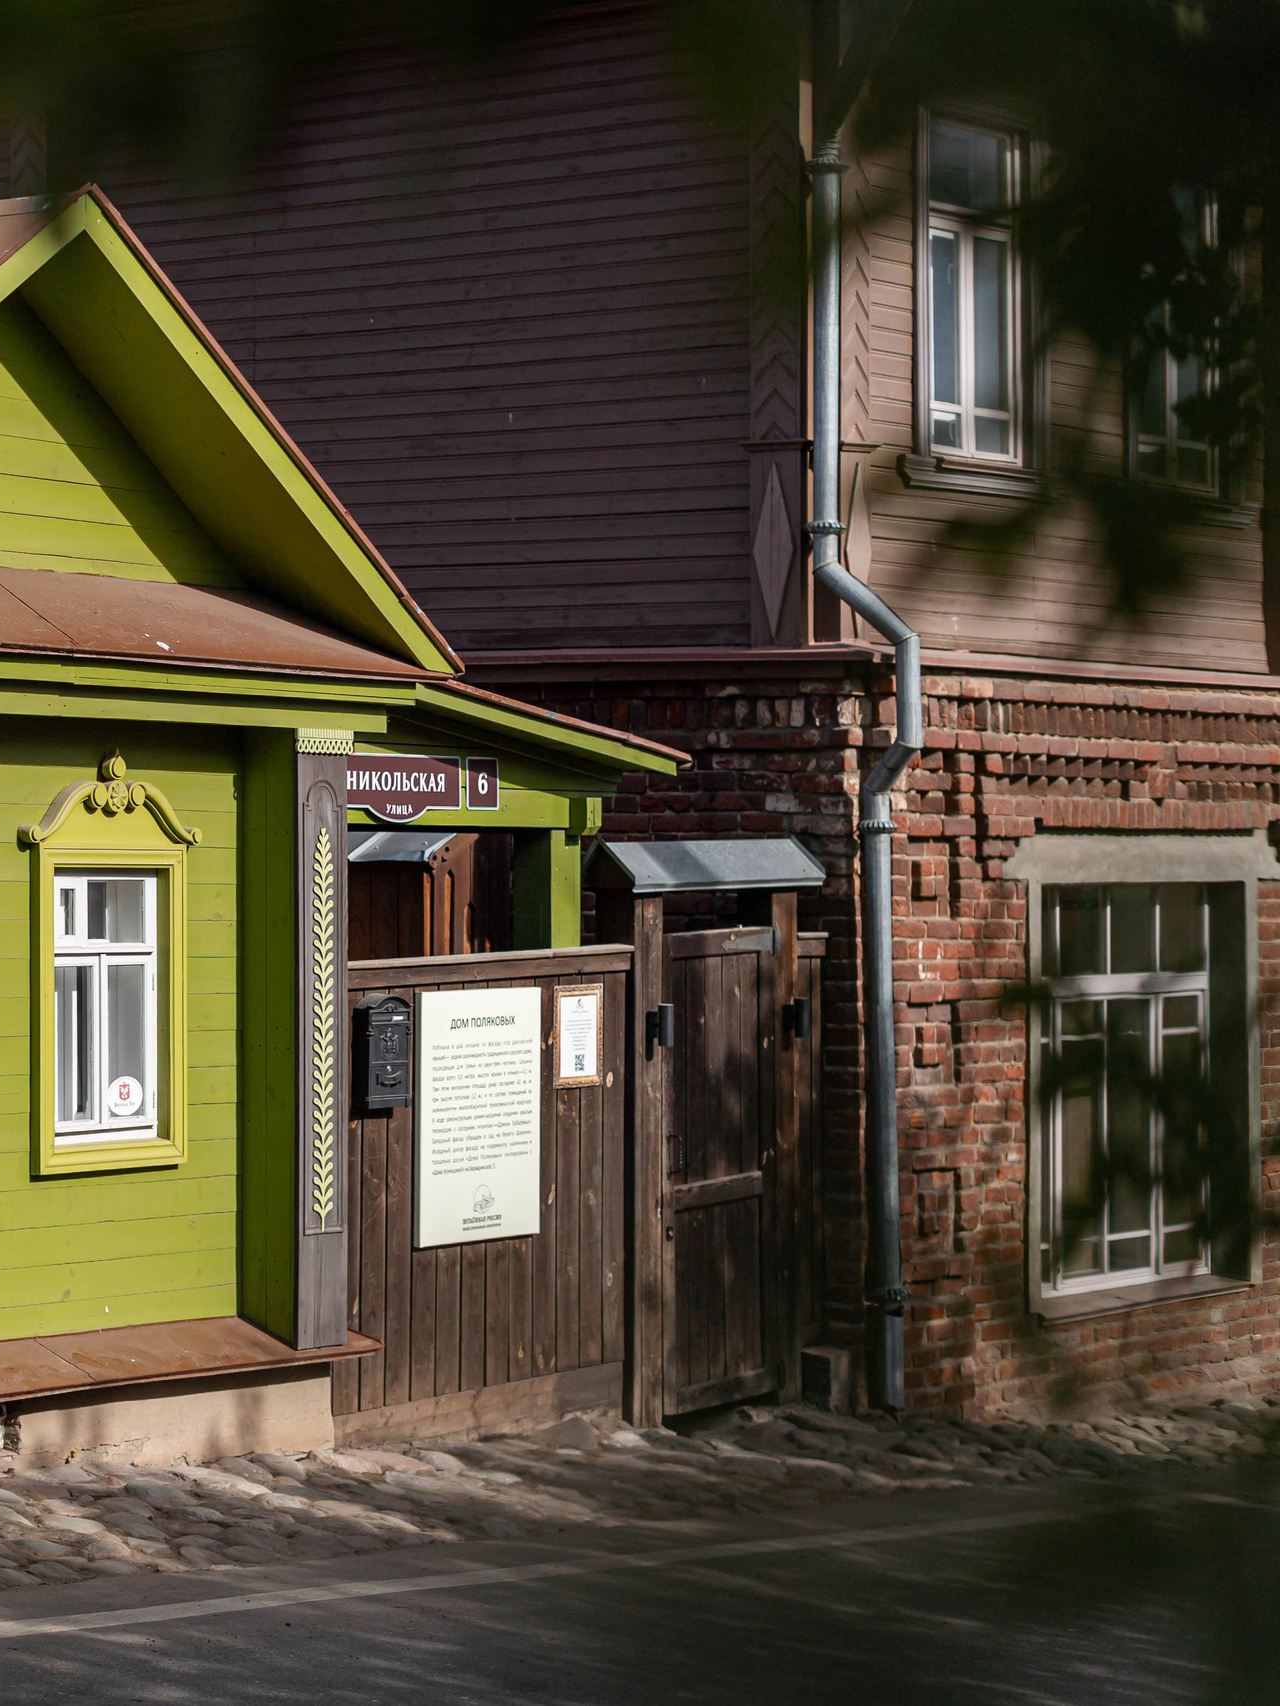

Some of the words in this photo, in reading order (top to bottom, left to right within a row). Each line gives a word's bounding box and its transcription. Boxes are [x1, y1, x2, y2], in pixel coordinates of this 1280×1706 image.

[346, 770, 446, 793] НИКОЛЬСКАЯ
[477, 772, 488, 795] 6
[385, 803, 413, 816] УЛИЦА
[450, 1017, 469, 1031] ДОМ
[470, 1015, 516, 1028] ПОЛЯКОВЫХ
